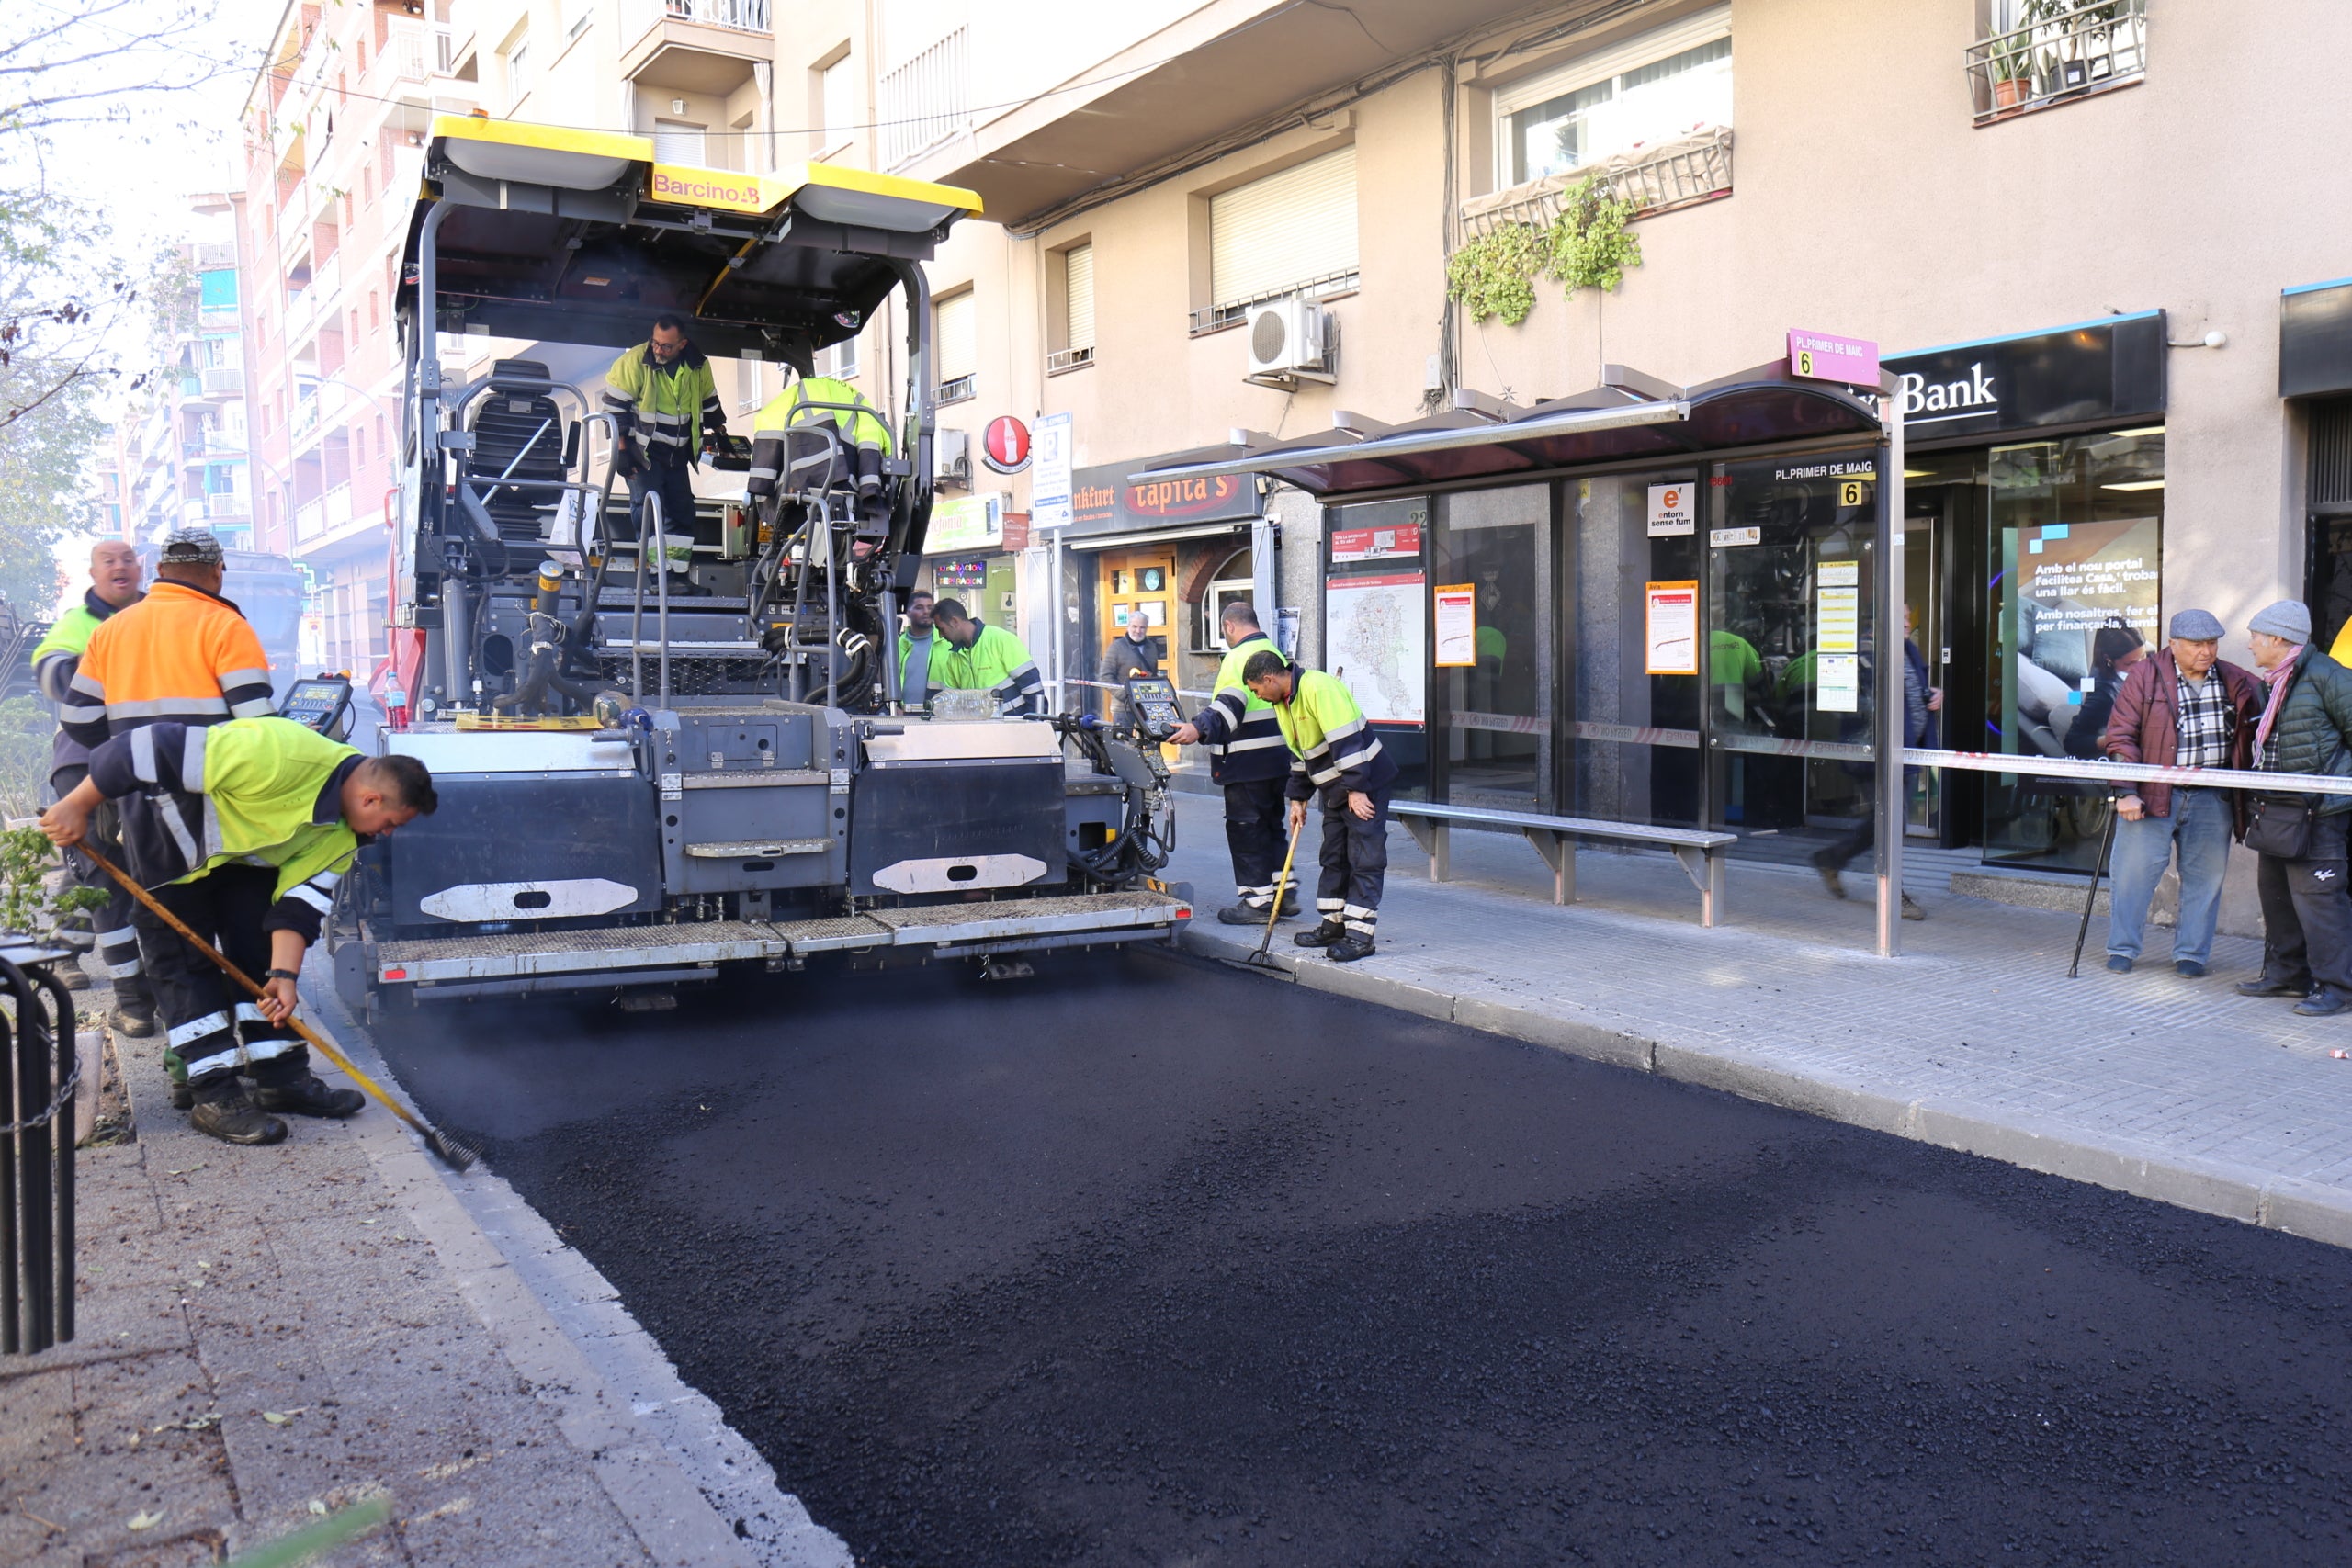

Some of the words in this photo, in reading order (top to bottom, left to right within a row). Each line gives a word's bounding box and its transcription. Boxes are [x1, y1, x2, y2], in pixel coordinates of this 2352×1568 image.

[654, 174, 739, 202] Barcino
[1796, 336, 1834, 354] PL.PRIMER
[1835, 342, 1845, 354] DE
[1801, 353, 1811, 374] 6
[1775, 465, 1827, 480] PL.PRIMER
[1829, 464, 1843, 475] DE
[1846, 461, 1872, 474] MAIG
[1073, 485, 1115, 510] nkfurt
[1845, 484, 1858, 503] 6
[1651, 518, 1673, 527] sense
[1676, 517, 1690, 525] fum
[1658, 511, 1683, 519] entorn
[2035, 563, 2063, 575] Amb
[2065, 562, 2076, 572] el
[2078, 563, 2102, 572] nou
[2105, 558, 2143, 572] portal
[2035, 573, 2083, 586] Facilitea
[2035, 588, 2057, 597] una
[2060, 585, 2079, 596] llar
[2082, 585, 2095, 596] és
[2098, 582, 2126, 594] fàcil.
[2035, 609, 2063, 620] Amb
[2065, 607, 2122, 619] nosaltres,
[2125, 605, 2143, 616] fer
[2146, 604, 2158, 615] el
[2035, 623, 2055, 634] per
[2057, 619, 2122, 632] finançar-la,
[2125, 618, 2158, 628] tamb
